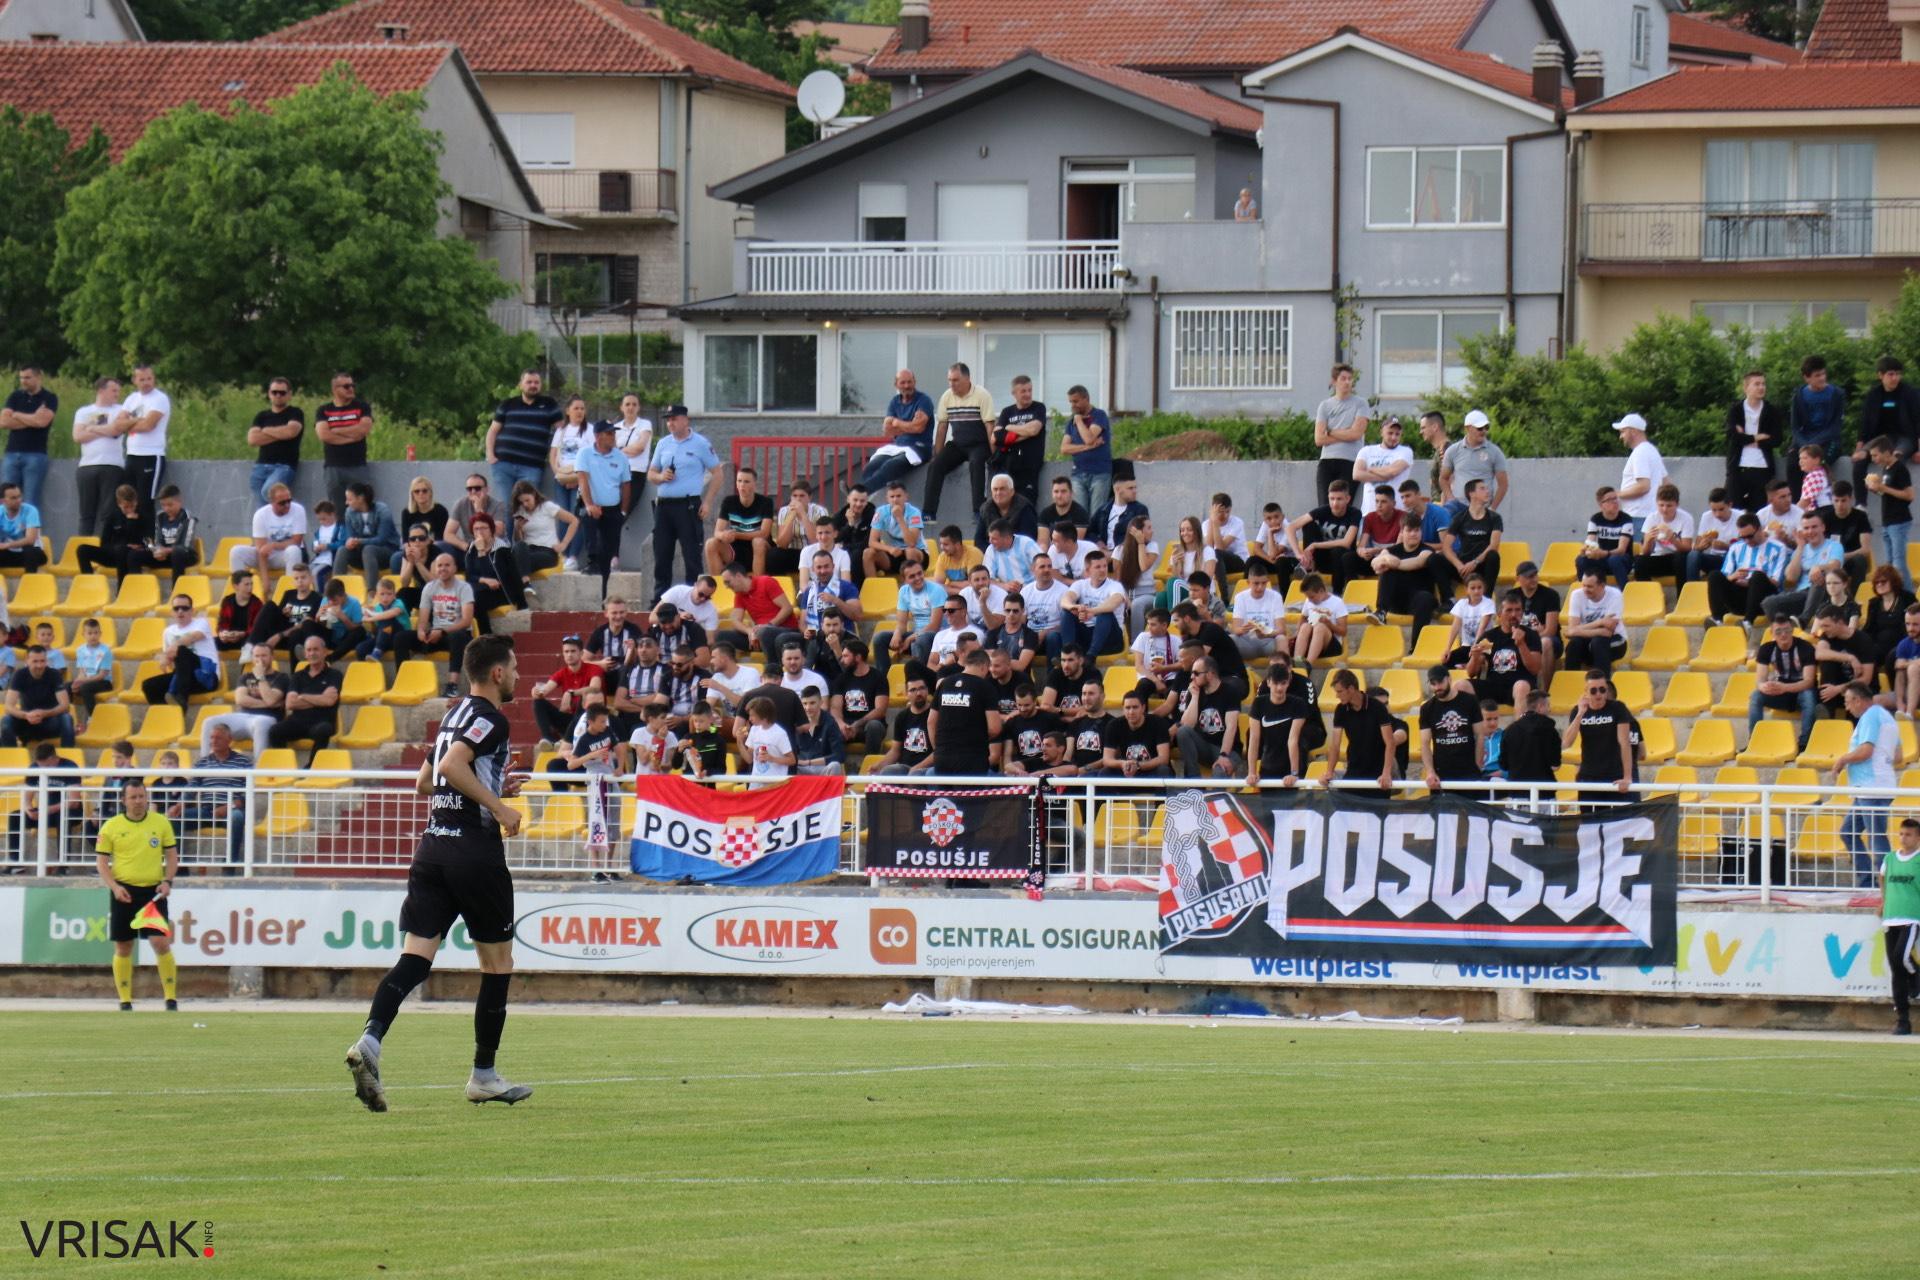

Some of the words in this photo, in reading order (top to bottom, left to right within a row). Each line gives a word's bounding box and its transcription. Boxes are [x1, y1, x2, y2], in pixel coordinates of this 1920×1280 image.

[1581, 715, 1613, 725] adidas
[643, 811, 713, 856] POS
[763, 811, 821, 854] ŠJE
[895, 847, 990, 867] POSUŠJE
[1264, 809, 1655, 949] POSUŠJE
[168, 907, 306, 956] telier
[541, 916, 662, 947] KAMEX
[715, 919, 838, 949] KAMEX
[878, 926, 908, 948] CO
[926, 926, 1035, 949] CENTRAL
[582, 945, 609, 956] d.o.o.
[758, 949, 785, 960] d.o.o.
[1639, 924, 1784, 976] IVA
[926, 955, 966, 968] Spojeni
[967, 956, 1035, 969] povjerenjem
